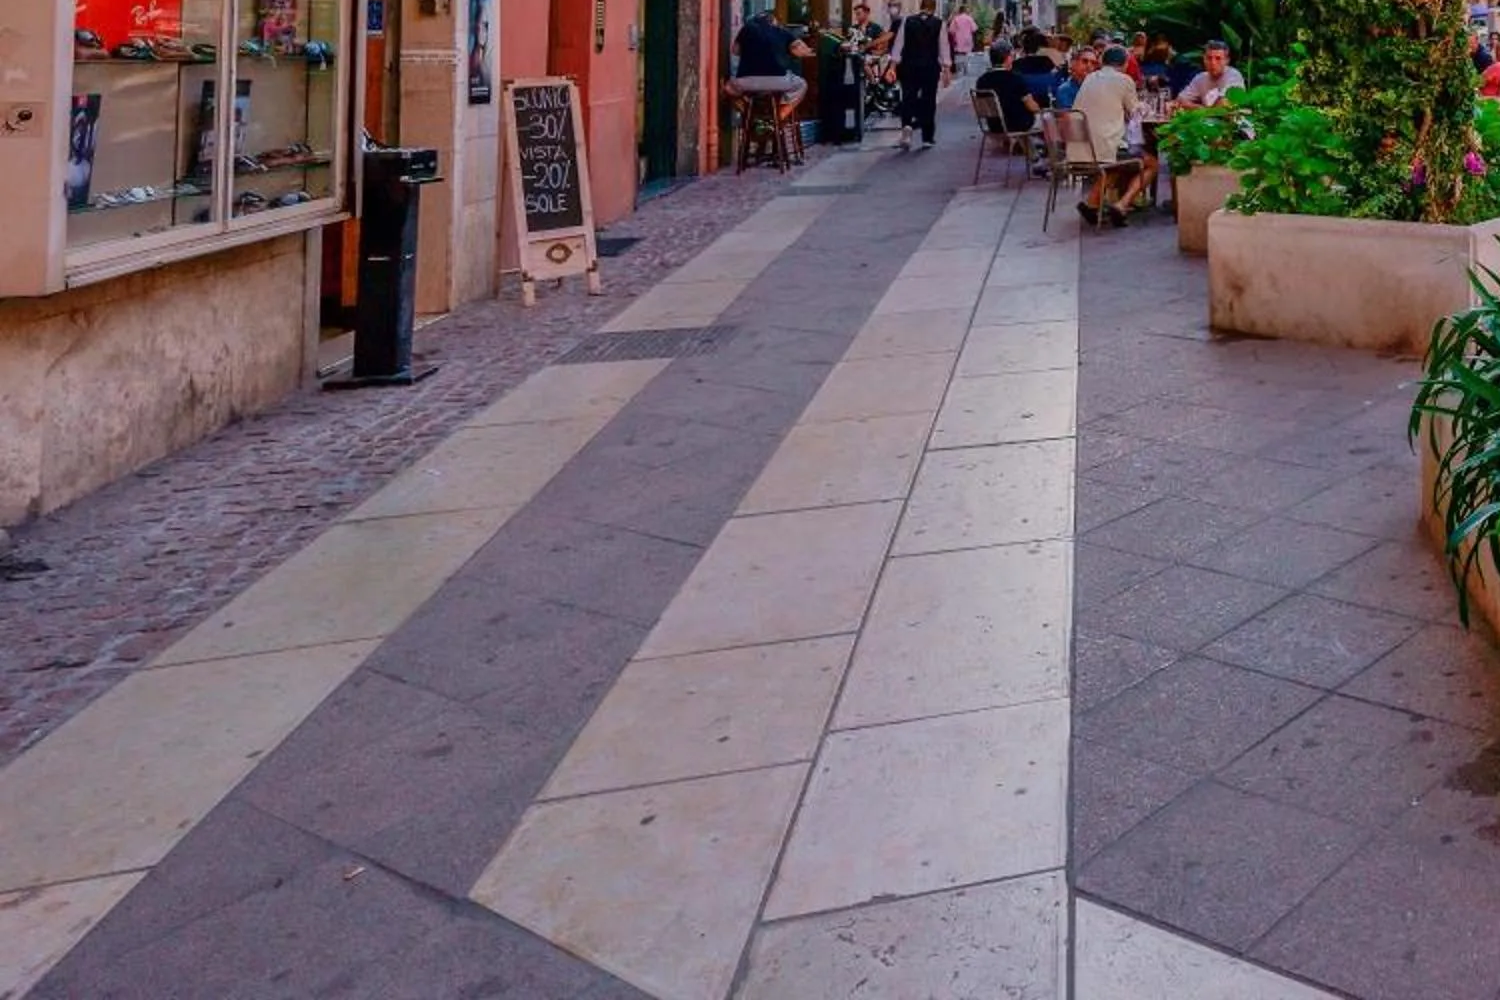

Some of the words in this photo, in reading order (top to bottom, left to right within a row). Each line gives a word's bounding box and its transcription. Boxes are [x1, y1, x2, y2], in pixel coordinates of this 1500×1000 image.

[520, 145, 569, 161] VISTA
[523, 160, 571, 190] -20%
[526, 193, 569, 214] SOLE
